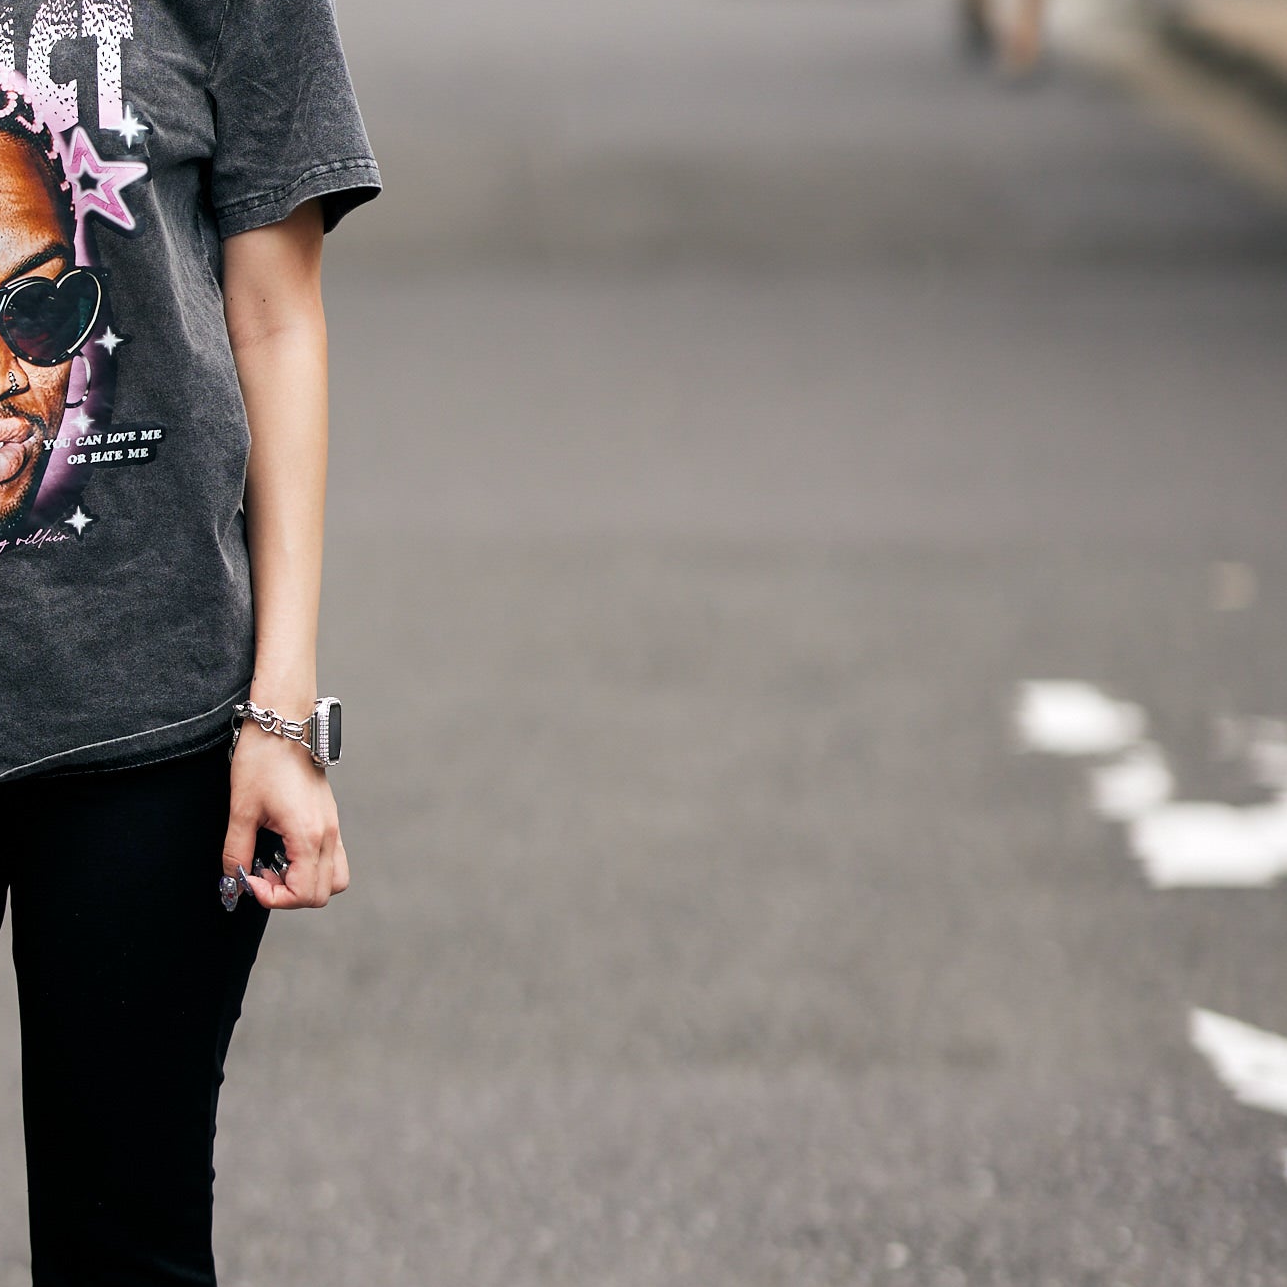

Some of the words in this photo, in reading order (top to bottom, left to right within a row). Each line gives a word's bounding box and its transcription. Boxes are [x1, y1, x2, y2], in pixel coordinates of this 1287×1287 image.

[43, 438, 71, 450] YOU
[76, 435, 102, 447] CAN
[107, 432, 136, 444] LOVE
[141, 429, 162, 441] ME
[67, 455, 86, 465] OR
[91, 449, 123, 463] HATE
[128, 448, 149, 459] ME
[16, 528, 70, 548] villain
